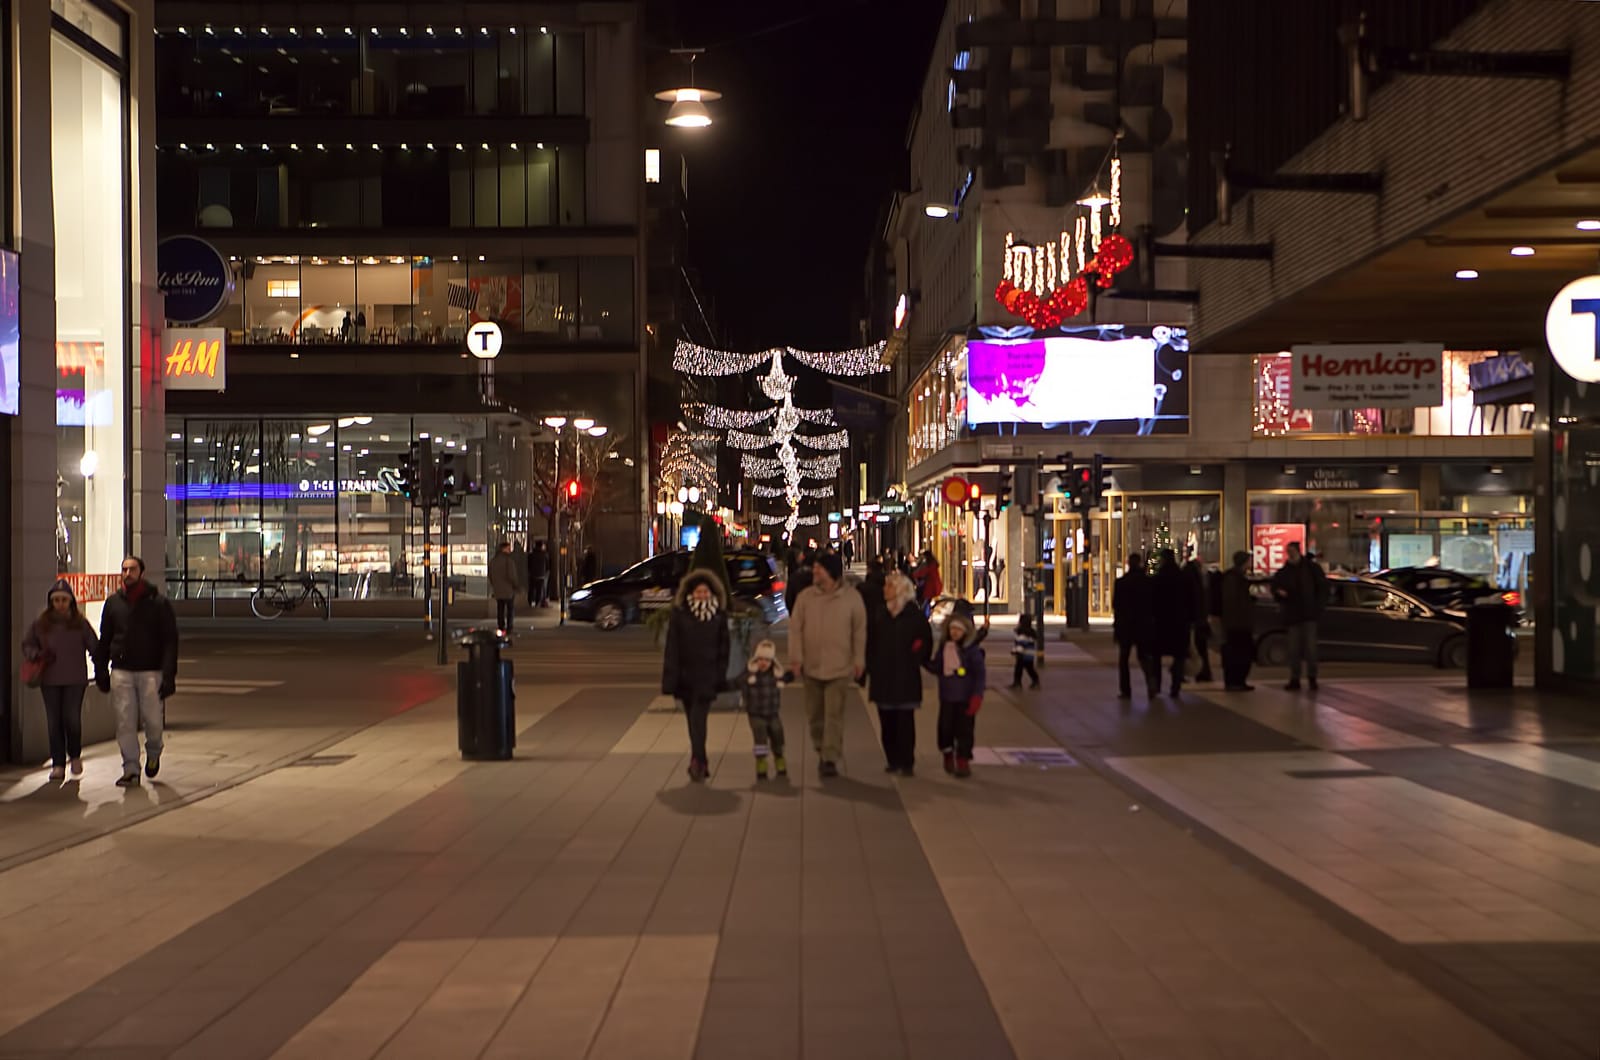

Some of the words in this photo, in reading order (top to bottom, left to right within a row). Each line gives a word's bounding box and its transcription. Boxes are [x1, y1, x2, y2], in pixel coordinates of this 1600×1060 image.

[474, 331, 494, 351] T
[166, 339, 220, 378] H&M
[1302, 352, 1436, 379] Hemköp
[313, 480, 378, 491] T-CETRALEN
[84, 575, 104, 601] SALE
